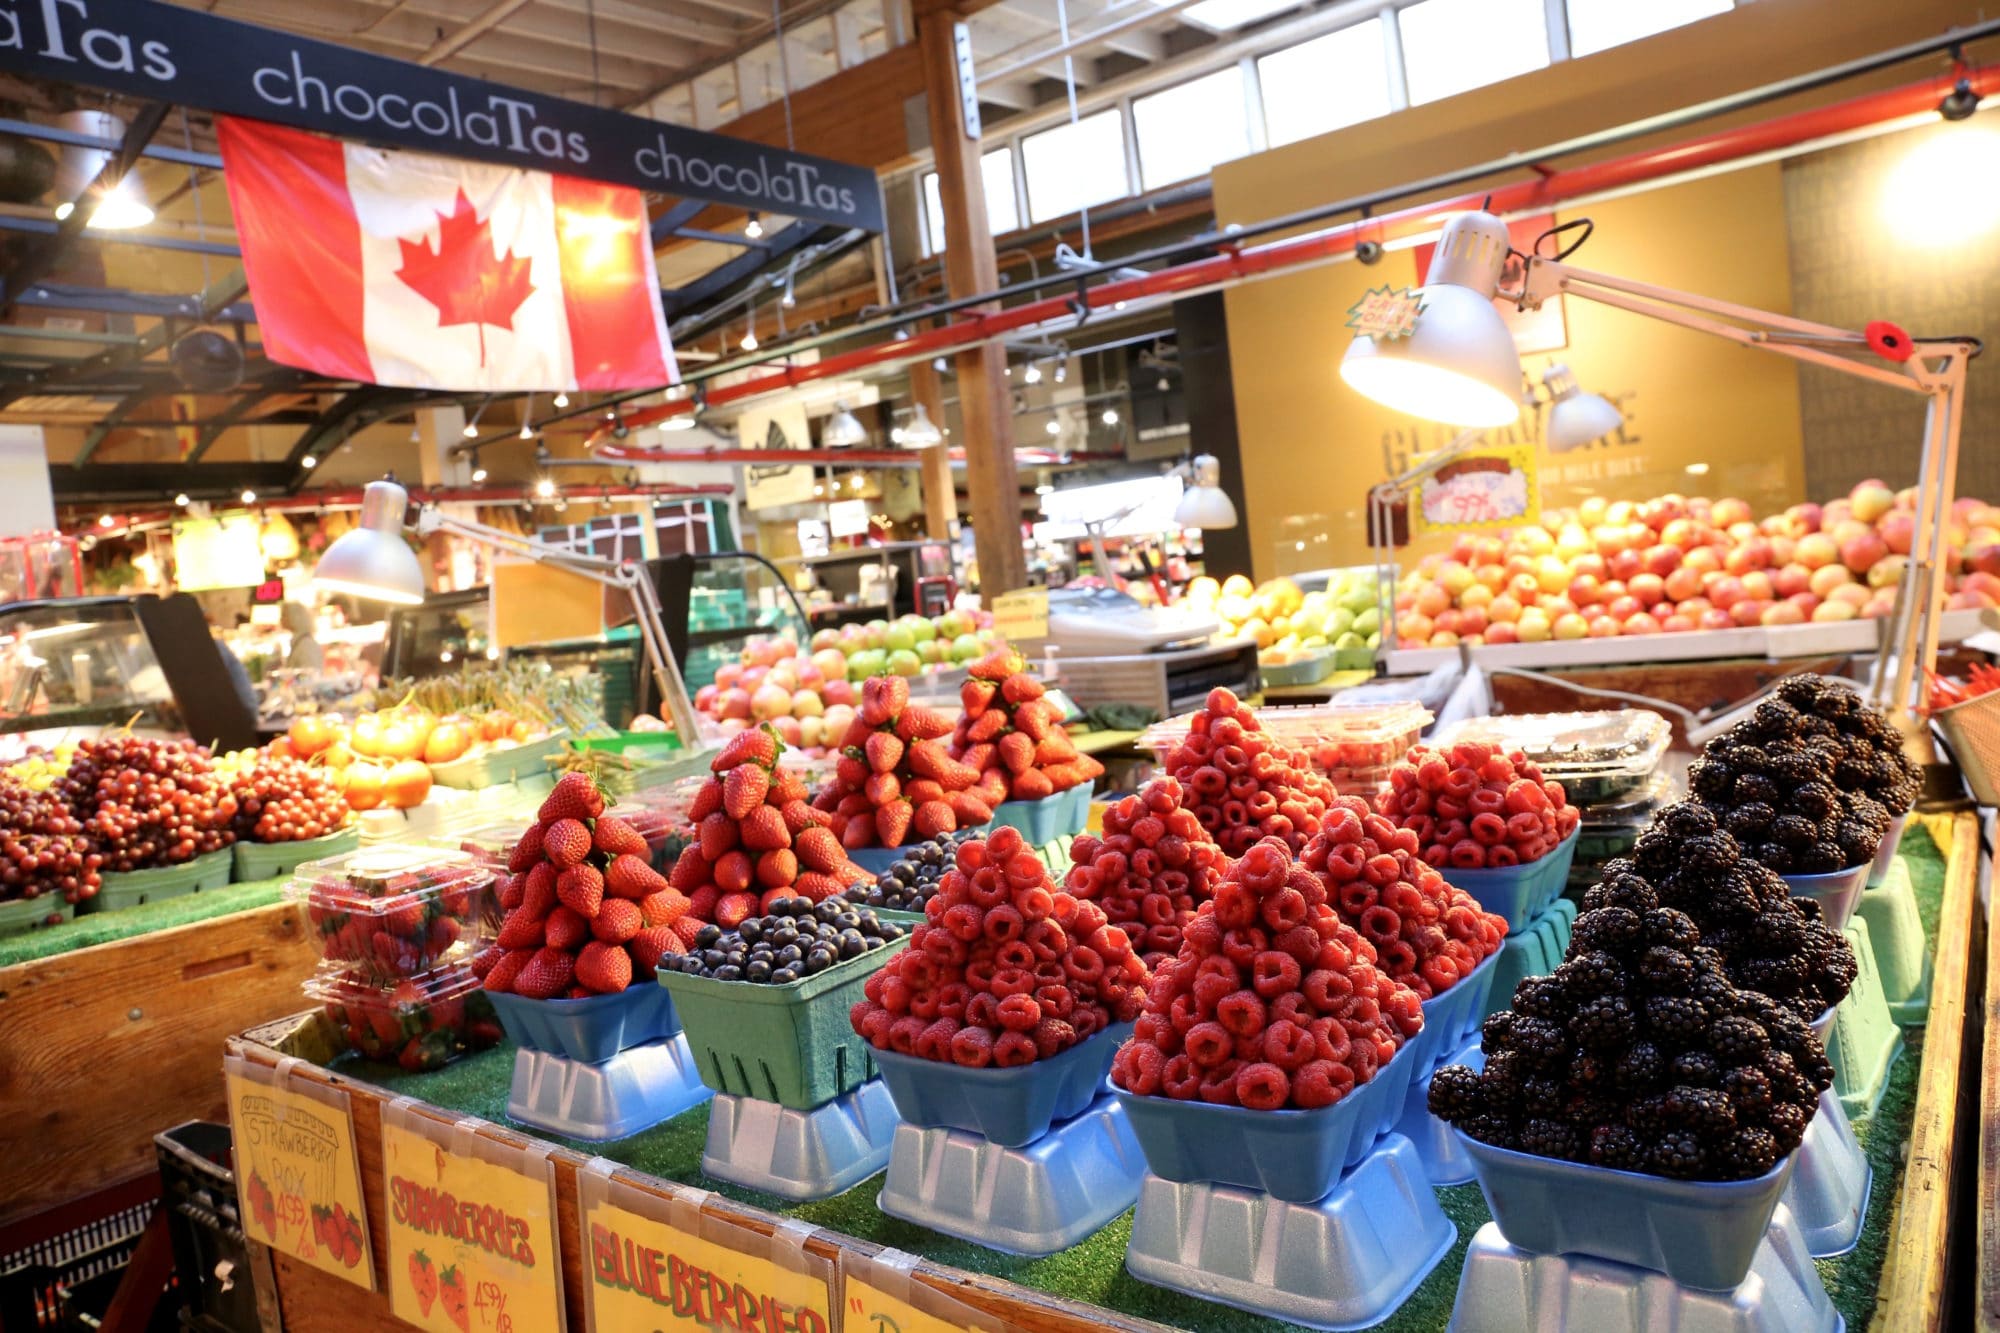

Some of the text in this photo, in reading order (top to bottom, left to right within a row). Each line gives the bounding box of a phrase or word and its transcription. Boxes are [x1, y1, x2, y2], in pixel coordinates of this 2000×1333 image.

[252, 50, 590, 164] chocolaTas
[634, 133, 856, 215] chocolaTas
[249, 1116, 333, 1163] STRAWBERRY
[390, 1174, 536, 1268] STRAWBERRIES
